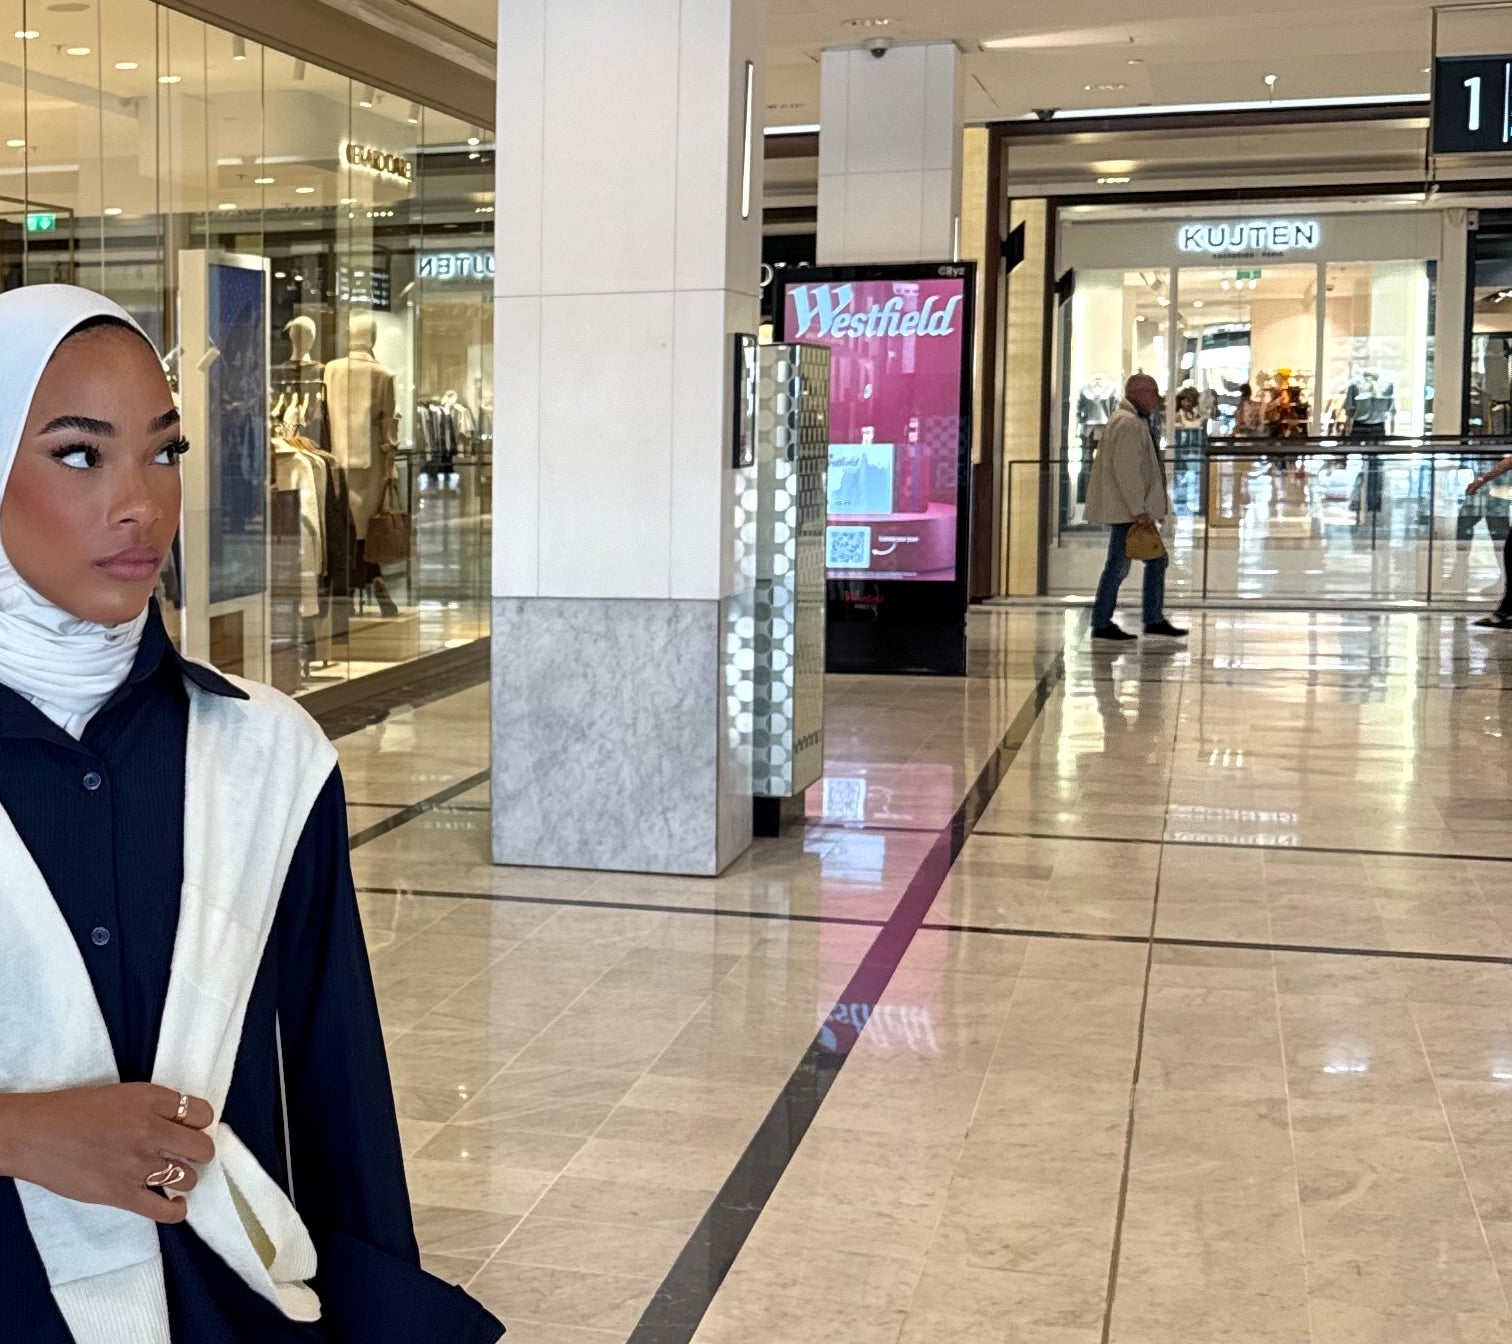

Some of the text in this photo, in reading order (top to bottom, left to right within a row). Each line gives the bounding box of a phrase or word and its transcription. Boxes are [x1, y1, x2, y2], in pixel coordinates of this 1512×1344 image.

[1463, 76, 1481, 131] 1
[1182, 224, 1315, 249] KUJTEN
[788, 283, 963, 339] Westfield
